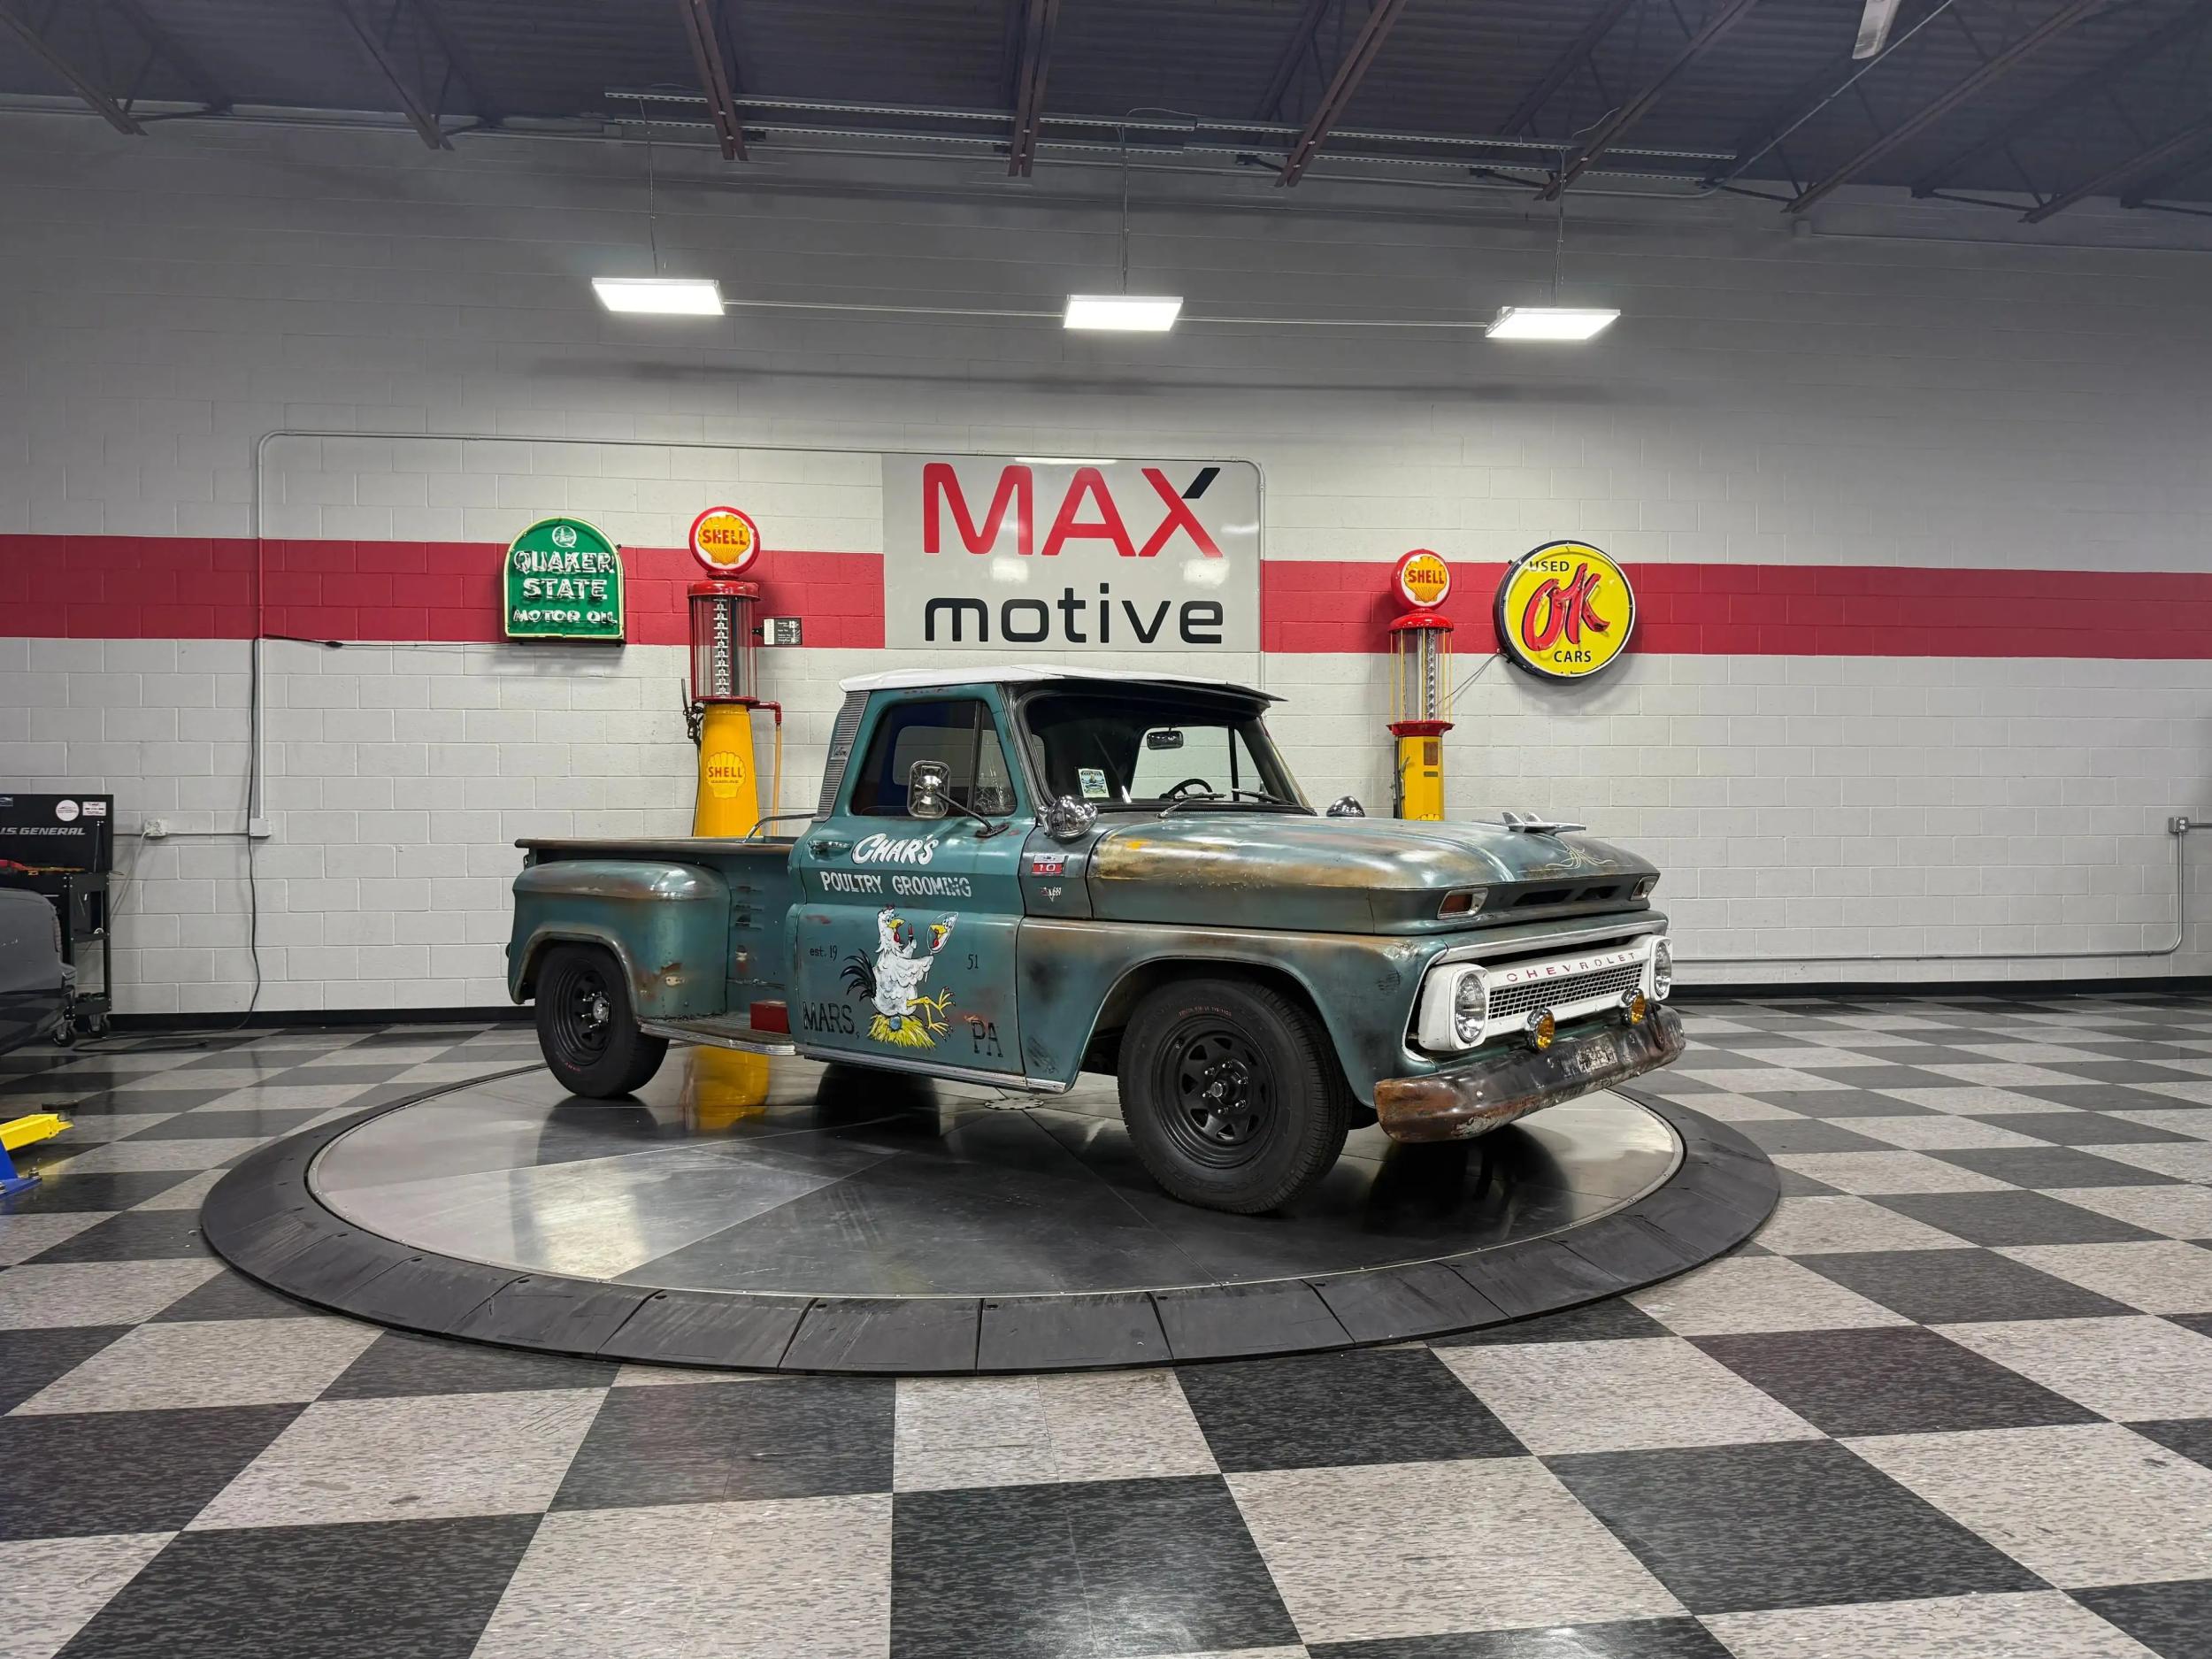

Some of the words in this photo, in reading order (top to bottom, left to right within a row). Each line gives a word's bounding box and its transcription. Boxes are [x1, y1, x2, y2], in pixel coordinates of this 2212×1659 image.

[923, 463, 1223, 557] MAX
[703, 529, 747, 545] SHELL
[514, 550, 615, 573] QUAKER
[1529, 561, 1570, 572] USED
[1408, 569, 1444, 584] SHELL
[523, 578, 607, 599] STATE
[513, 610, 580, 623] MOTOR
[587, 611, 618, 624] OIL
[925, 582, 1223, 644] motive
[1522, 563, 1610, 651] OK
[1554, 650, 1591, 663] CARS
[708, 766, 742, 778] SHELL
[819, 871, 883, 894] POULTRY
[892, 874, 972, 897] GROOMING
[830, 945, 838, 961] 19
[967, 954, 979, 970] 51
[1506, 952, 1635, 982] CHEVROLET
[803, 1001, 860, 1040] MARS,
[971, 1019, 1003, 1057] PA
